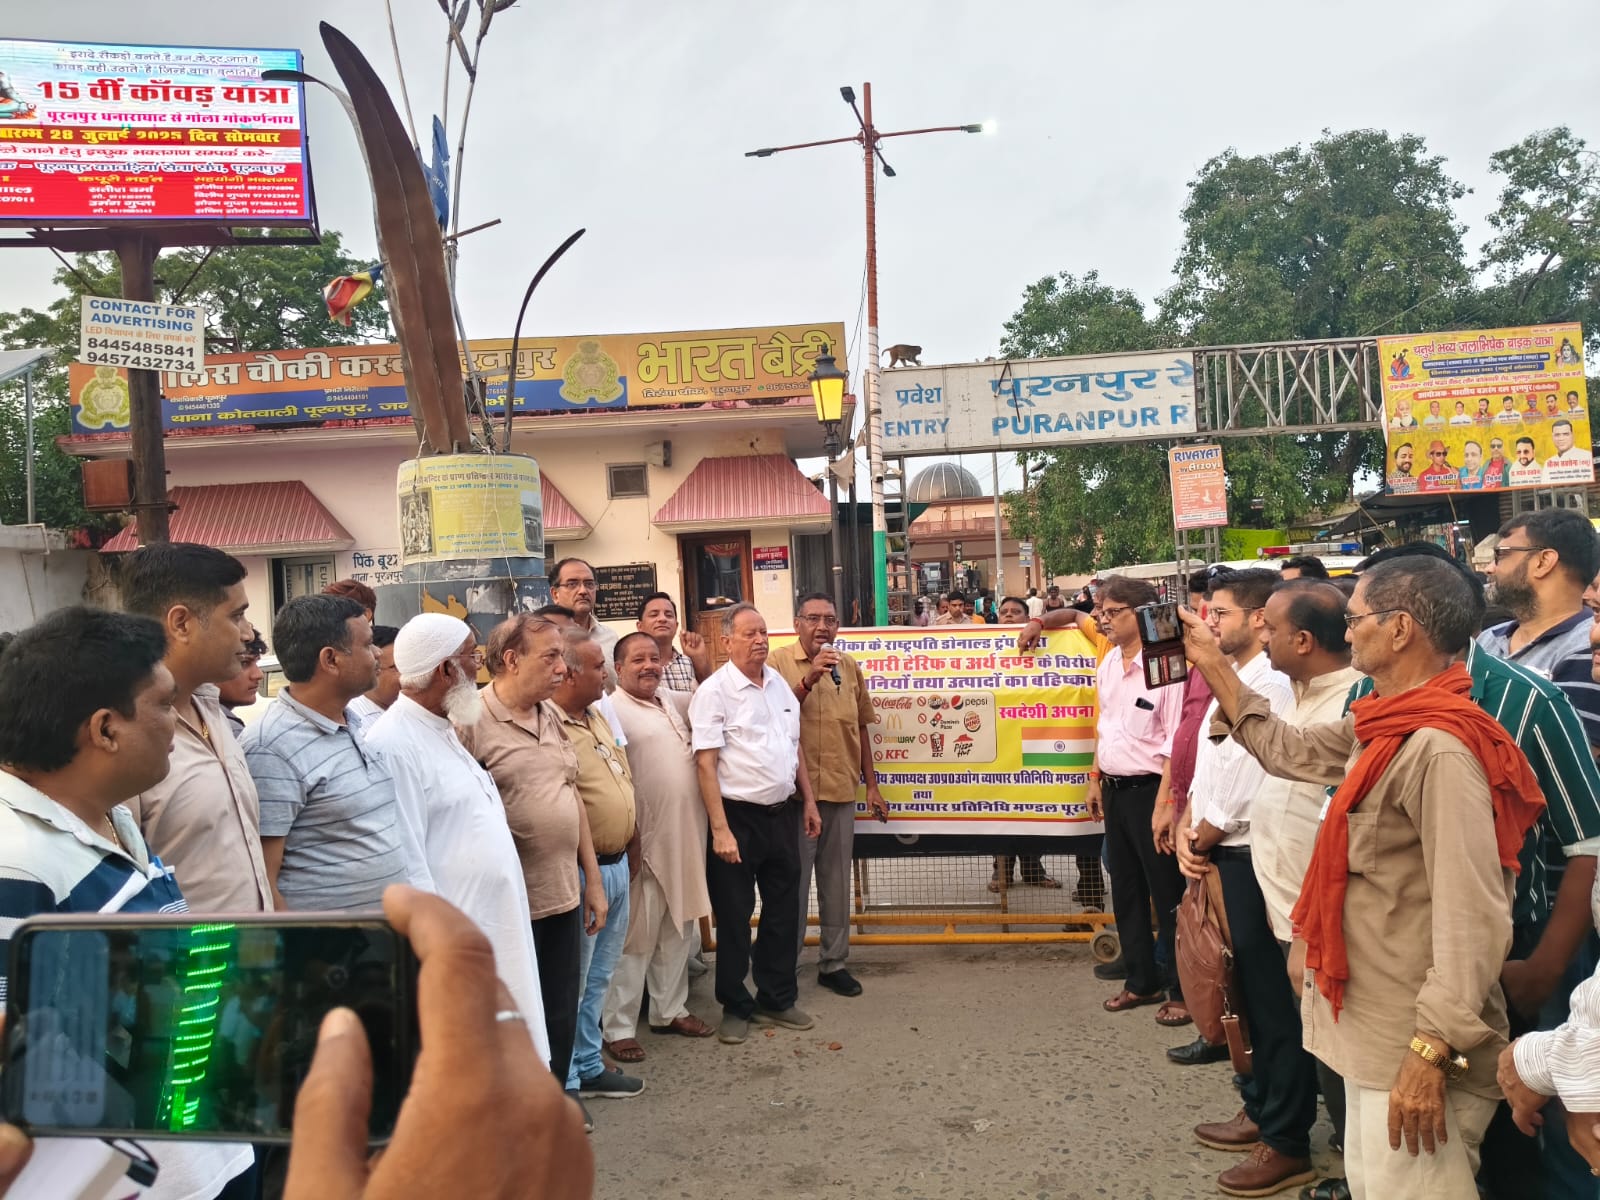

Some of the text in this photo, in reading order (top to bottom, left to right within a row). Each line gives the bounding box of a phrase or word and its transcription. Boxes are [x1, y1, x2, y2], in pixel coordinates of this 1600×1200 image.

[110, 64, 138, 73] उठाते
[37, 81, 80, 99] 15
[87, 78, 125, 101] वीं
[221, 86, 292, 104] यात्रा
[47, 111, 98, 124] पूरनपुर
[170, 112, 182, 122] से
[185, 112, 219, 123] गोला
[222, 112, 294, 124] गोकर्णनाथ
[50, 129, 73, 140] 28
[80, 127, 131, 144] जुलाई
[188, 128, 219, 142] दिन
[223, 129, 280, 143] सोमवार
[22, 146, 54, 155] जाने
[59, 147, 82, 158] हेतु
[35, 161, 91, 173] पूरनपुर
[161, 161, 193, 172] सेवा
[231, 164, 286, 175] पूरनपुर
[90, 299, 196, 319] CONTACT FOR
[85, 325, 102, 334] LED
[91, 313, 193, 331] ADVERTISING
[87, 337, 195, 357] 8445485841
[1437, 343, 1456, 353] भव्य
[1458, 335, 1505, 353] जलाभिषेक
[1534, 336, 1554, 346] यात्रा
[87, 351, 196, 371] 9457432734
[247, 351, 334, 383] चौकी
[636, 335, 758, 385] भारत
[896, 382, 942, 409] प्रवेश
[989, 367, 1161, 410] पूरनपुर
[171, 413, 212, 422] थाना
[216, 405, 299, 419] कोतवाली
[991, 405, 1161, 436] PURANPUR
[884, 417, 950, 438] ENTRY
[1174, 448, 1220, 462] RIVAYAT
[352, 552, 374, 568] पिंक
[375, 571, 404, 584] पूरनपु
[867, 637, 882, 651] के
[884, 636, 939, 653] राष्ट्रपति
[941, 636, 992, 650] डोनाल्ड
[994, 634, 1016, 651] ट्रंप
[866, 655, 901, 671] भारी
[950, 656, 963, 670] व
[965, 652, 996, 670] अर्थ
[998, 656, 1035, 669] दण्ड
[1036, 654, 1052, 668] के
[1054, 654, 1097, 669] विरोध
[912, 677, 945, 689] तथा
[947, 672, 1003, 689] उत्पादों
[1004, 676, 1029, 688] का
[1030, 671, 1097, 687] बहिष्का
[964, 697, 988, 707] pepsi
[999, 702, 1048, 720] स्वदेशी
[885, 750, 909, 760] KFC
[981, 773, 1011, 784] व्यापार
[1013, 770, 1053, 784] प्रतिनिधि
[1055, 772, 1085, 784] मण्डल
[913, 790, 932, 799] तथा
[905, 803, 949, 811] व्यापार
[951, 800, 1010, 812] प्रतिनिधि
[1013, 803, 1059, 812] मण्डल
